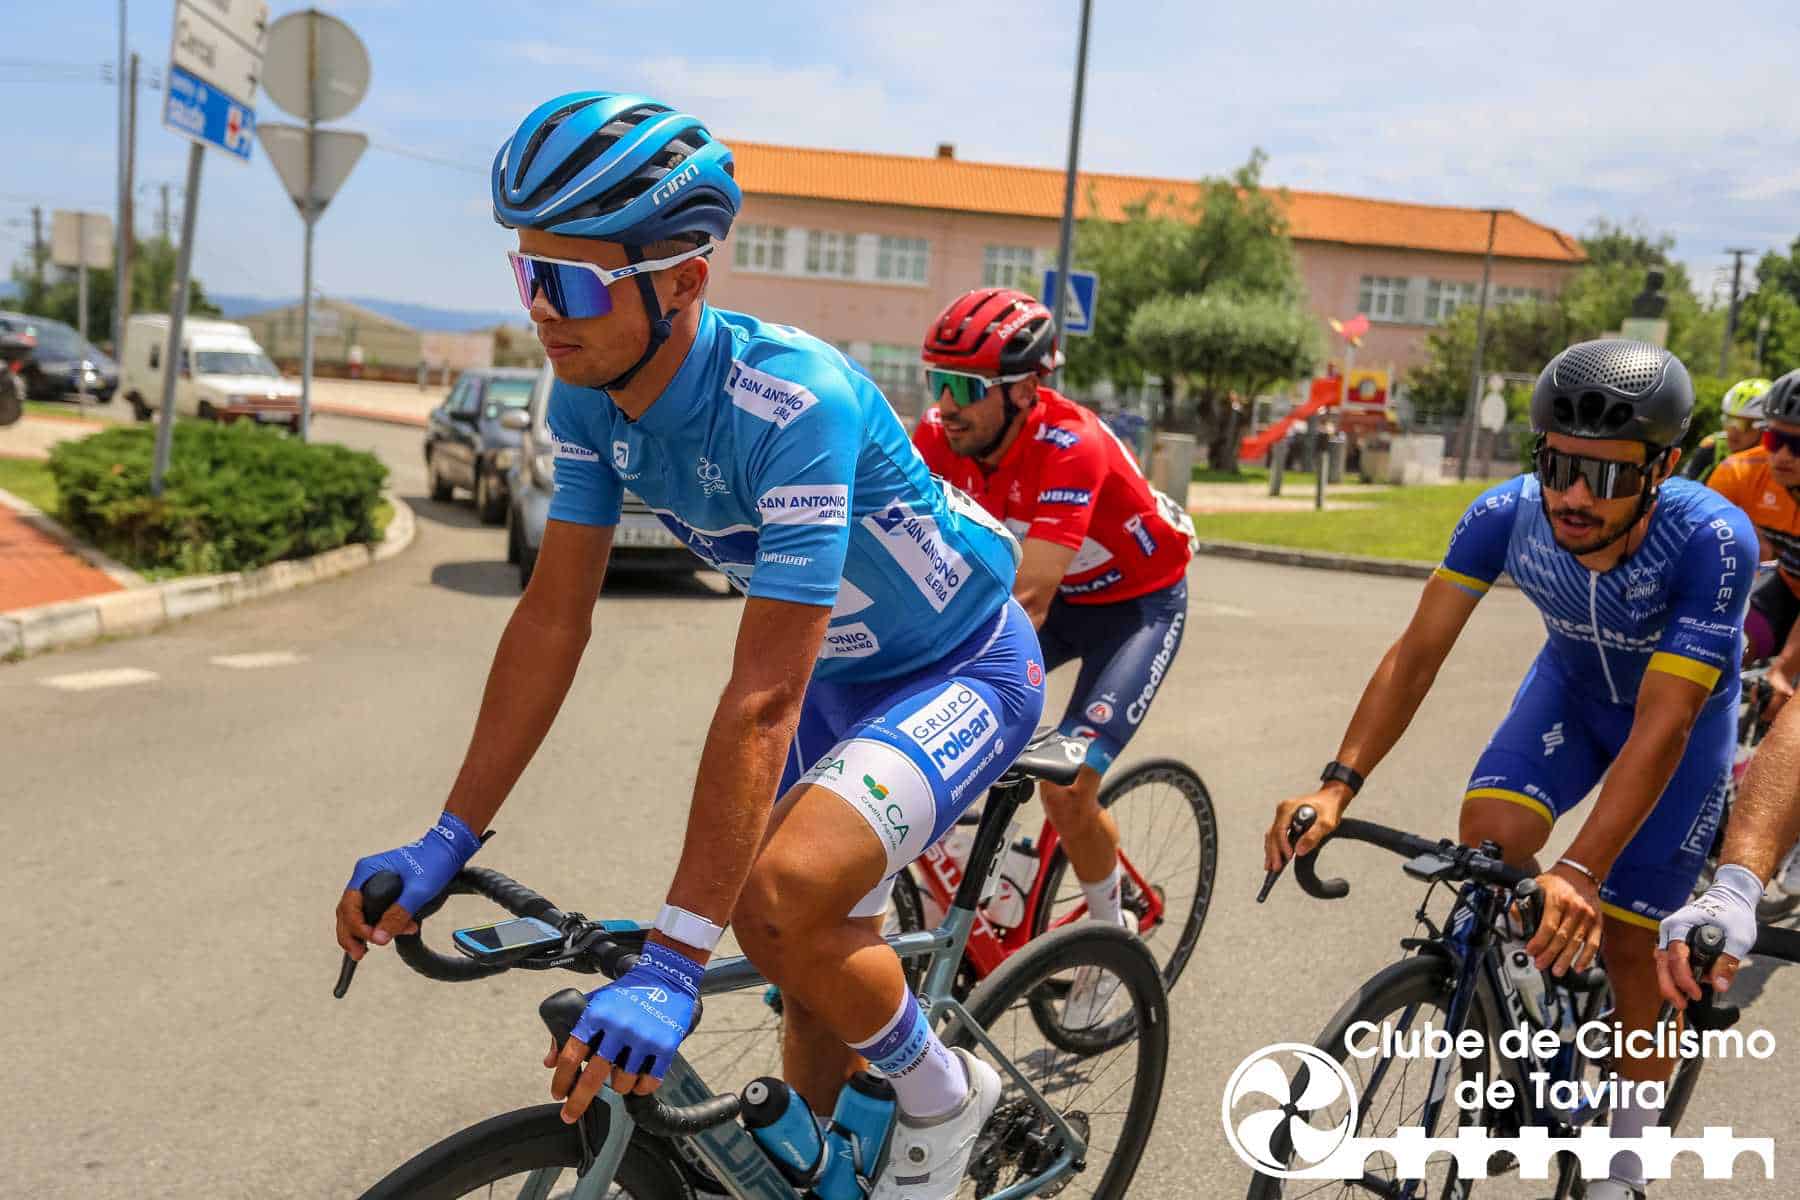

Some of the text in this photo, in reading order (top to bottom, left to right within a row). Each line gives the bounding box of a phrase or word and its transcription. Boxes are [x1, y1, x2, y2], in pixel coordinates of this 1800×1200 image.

[740, 377, 763, 395] SAN
[759, 495, 846, 509] SAN ANTONIO
[1449, 491, 1513, 547] OLFLEX
[903, 518, 959, 588] SAN ANTONIO
[1709, 518, 1737, 614] BOLFLEX
[825, 632, 867, 645] ONIO
[1126, 612, 1185, 725] Credibom
[912, 689, 973, 741] GRUPO
[931, 707, 990, 769] rolear
[815, 757, 845, 775] CA
[886, 803, 910, 845] CA
